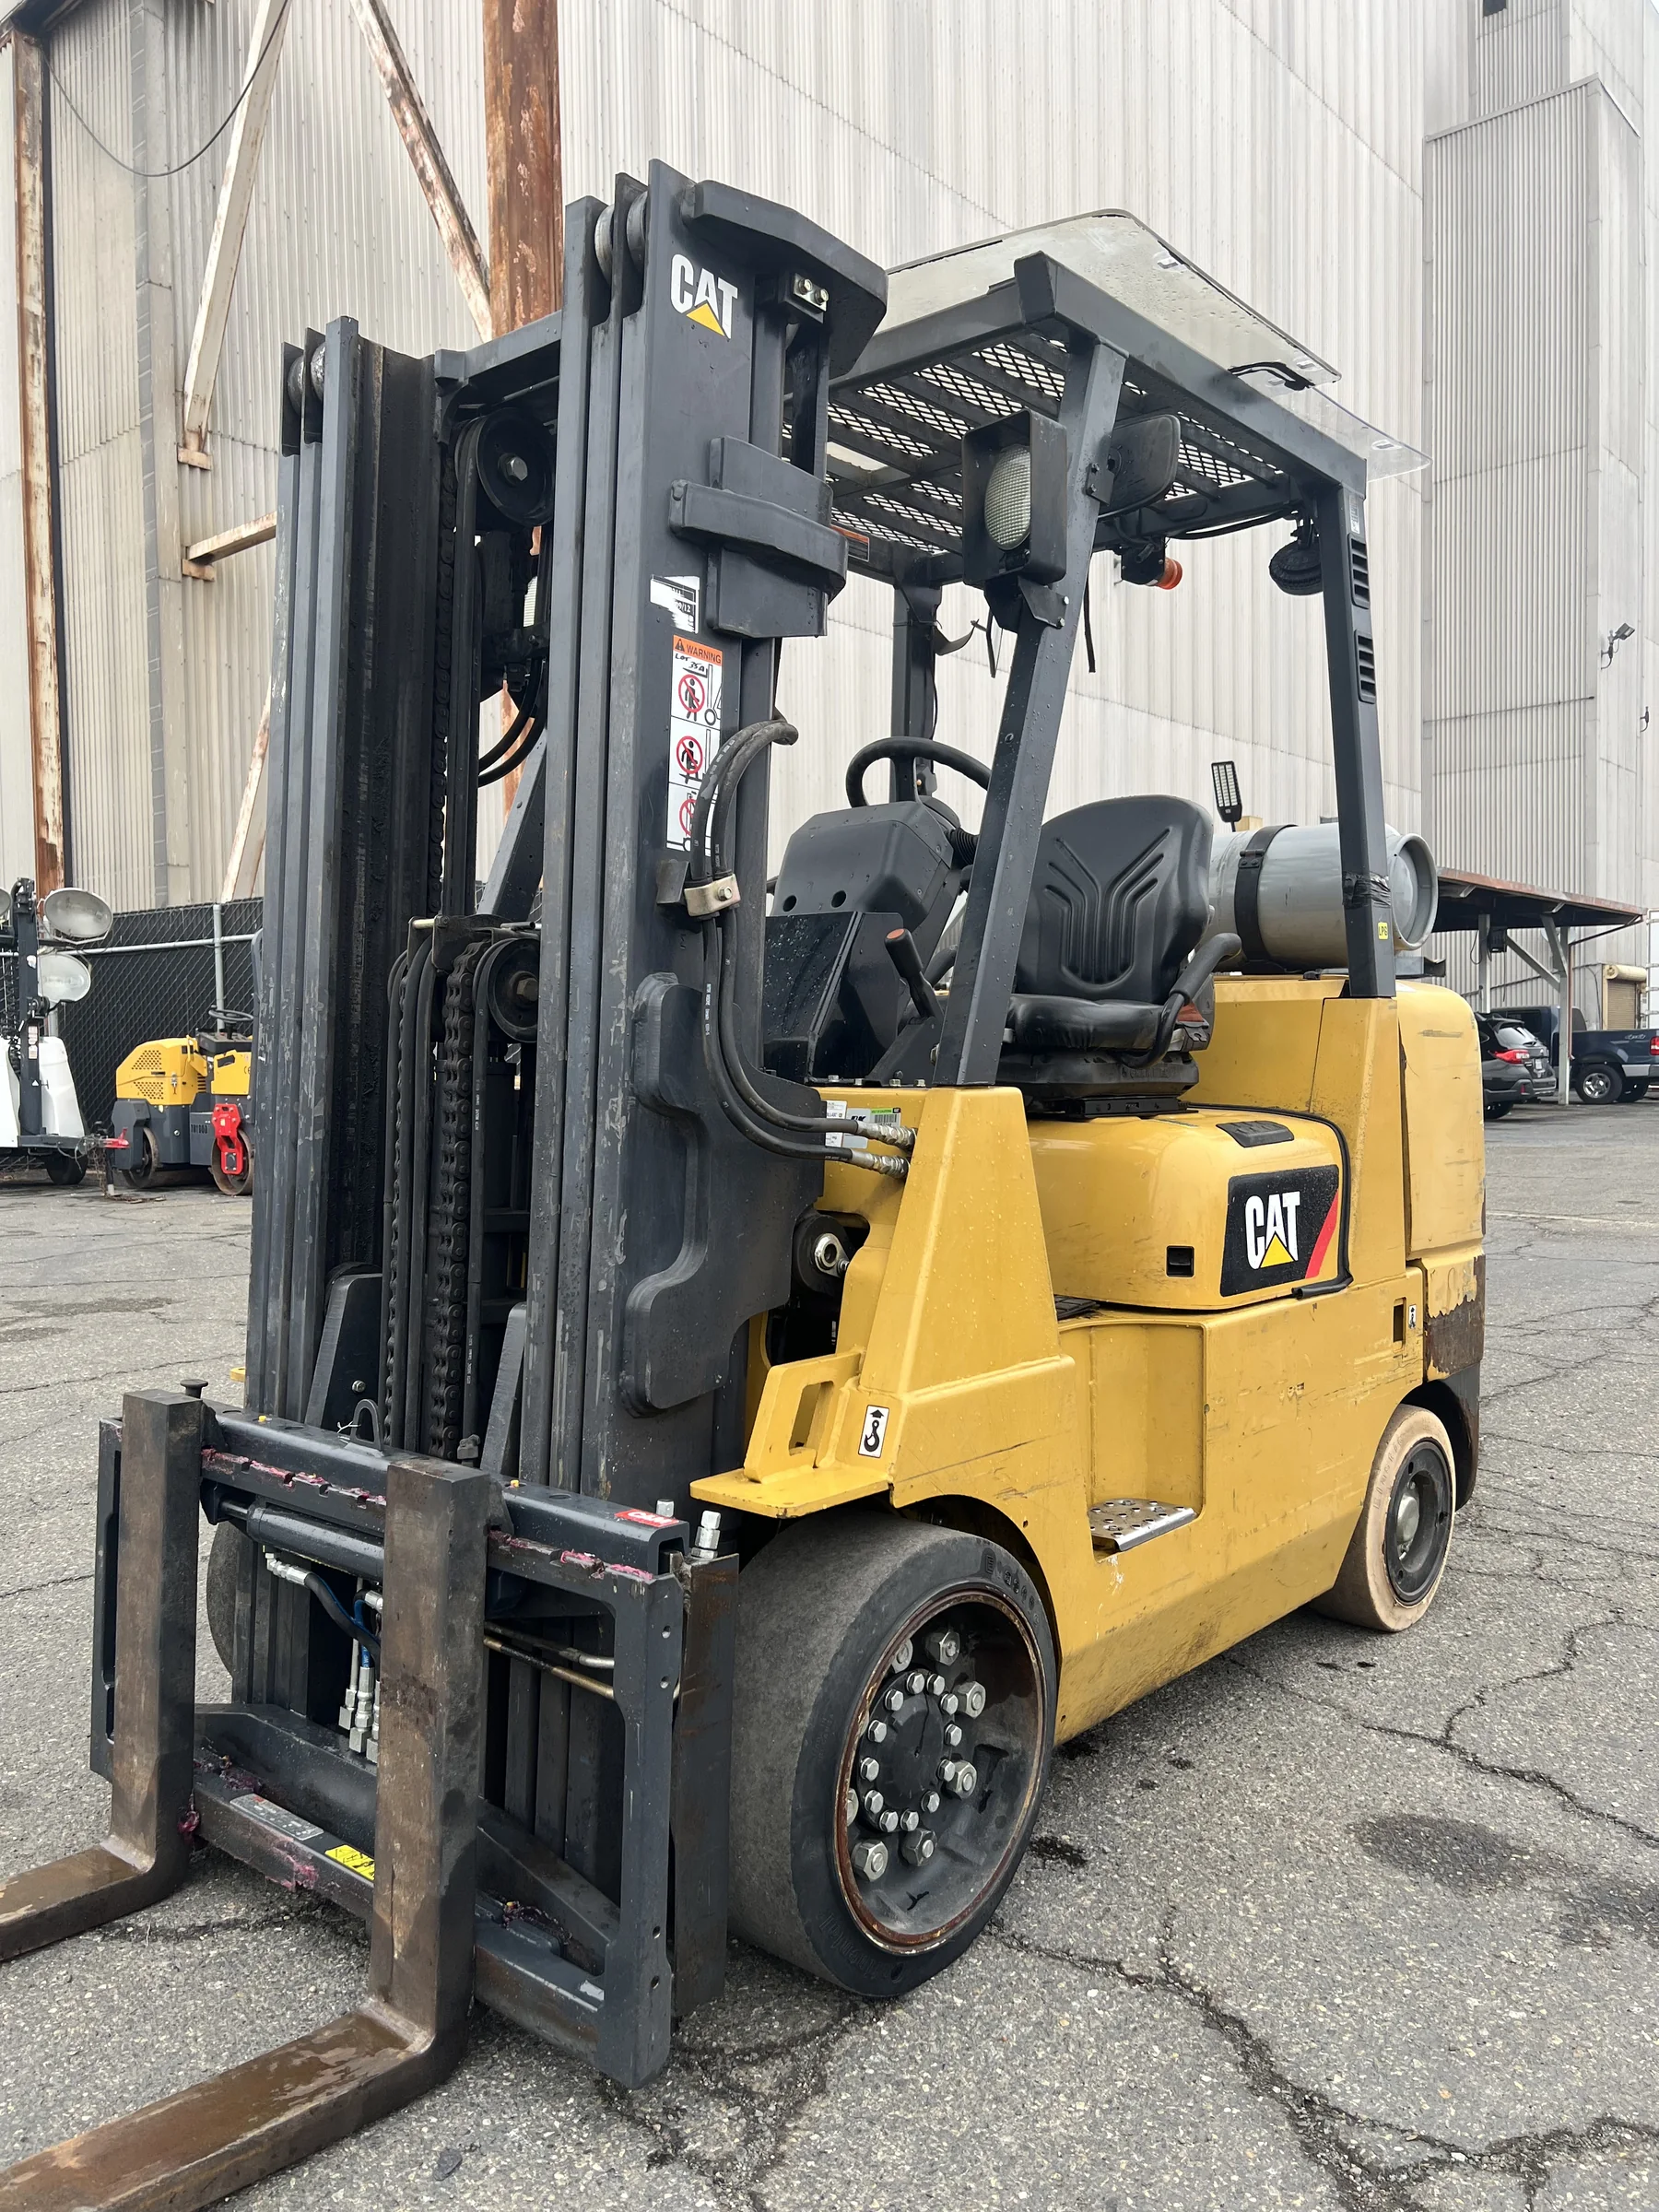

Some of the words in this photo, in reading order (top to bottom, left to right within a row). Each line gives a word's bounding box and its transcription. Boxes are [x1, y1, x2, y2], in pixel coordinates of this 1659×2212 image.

[671, 254, 737, 339] CAT
[687, 644, 722, 664] WARNING
[1379, 925, 1387, 936] LPG
[1245, 1191, 1300, 1270] CAT
